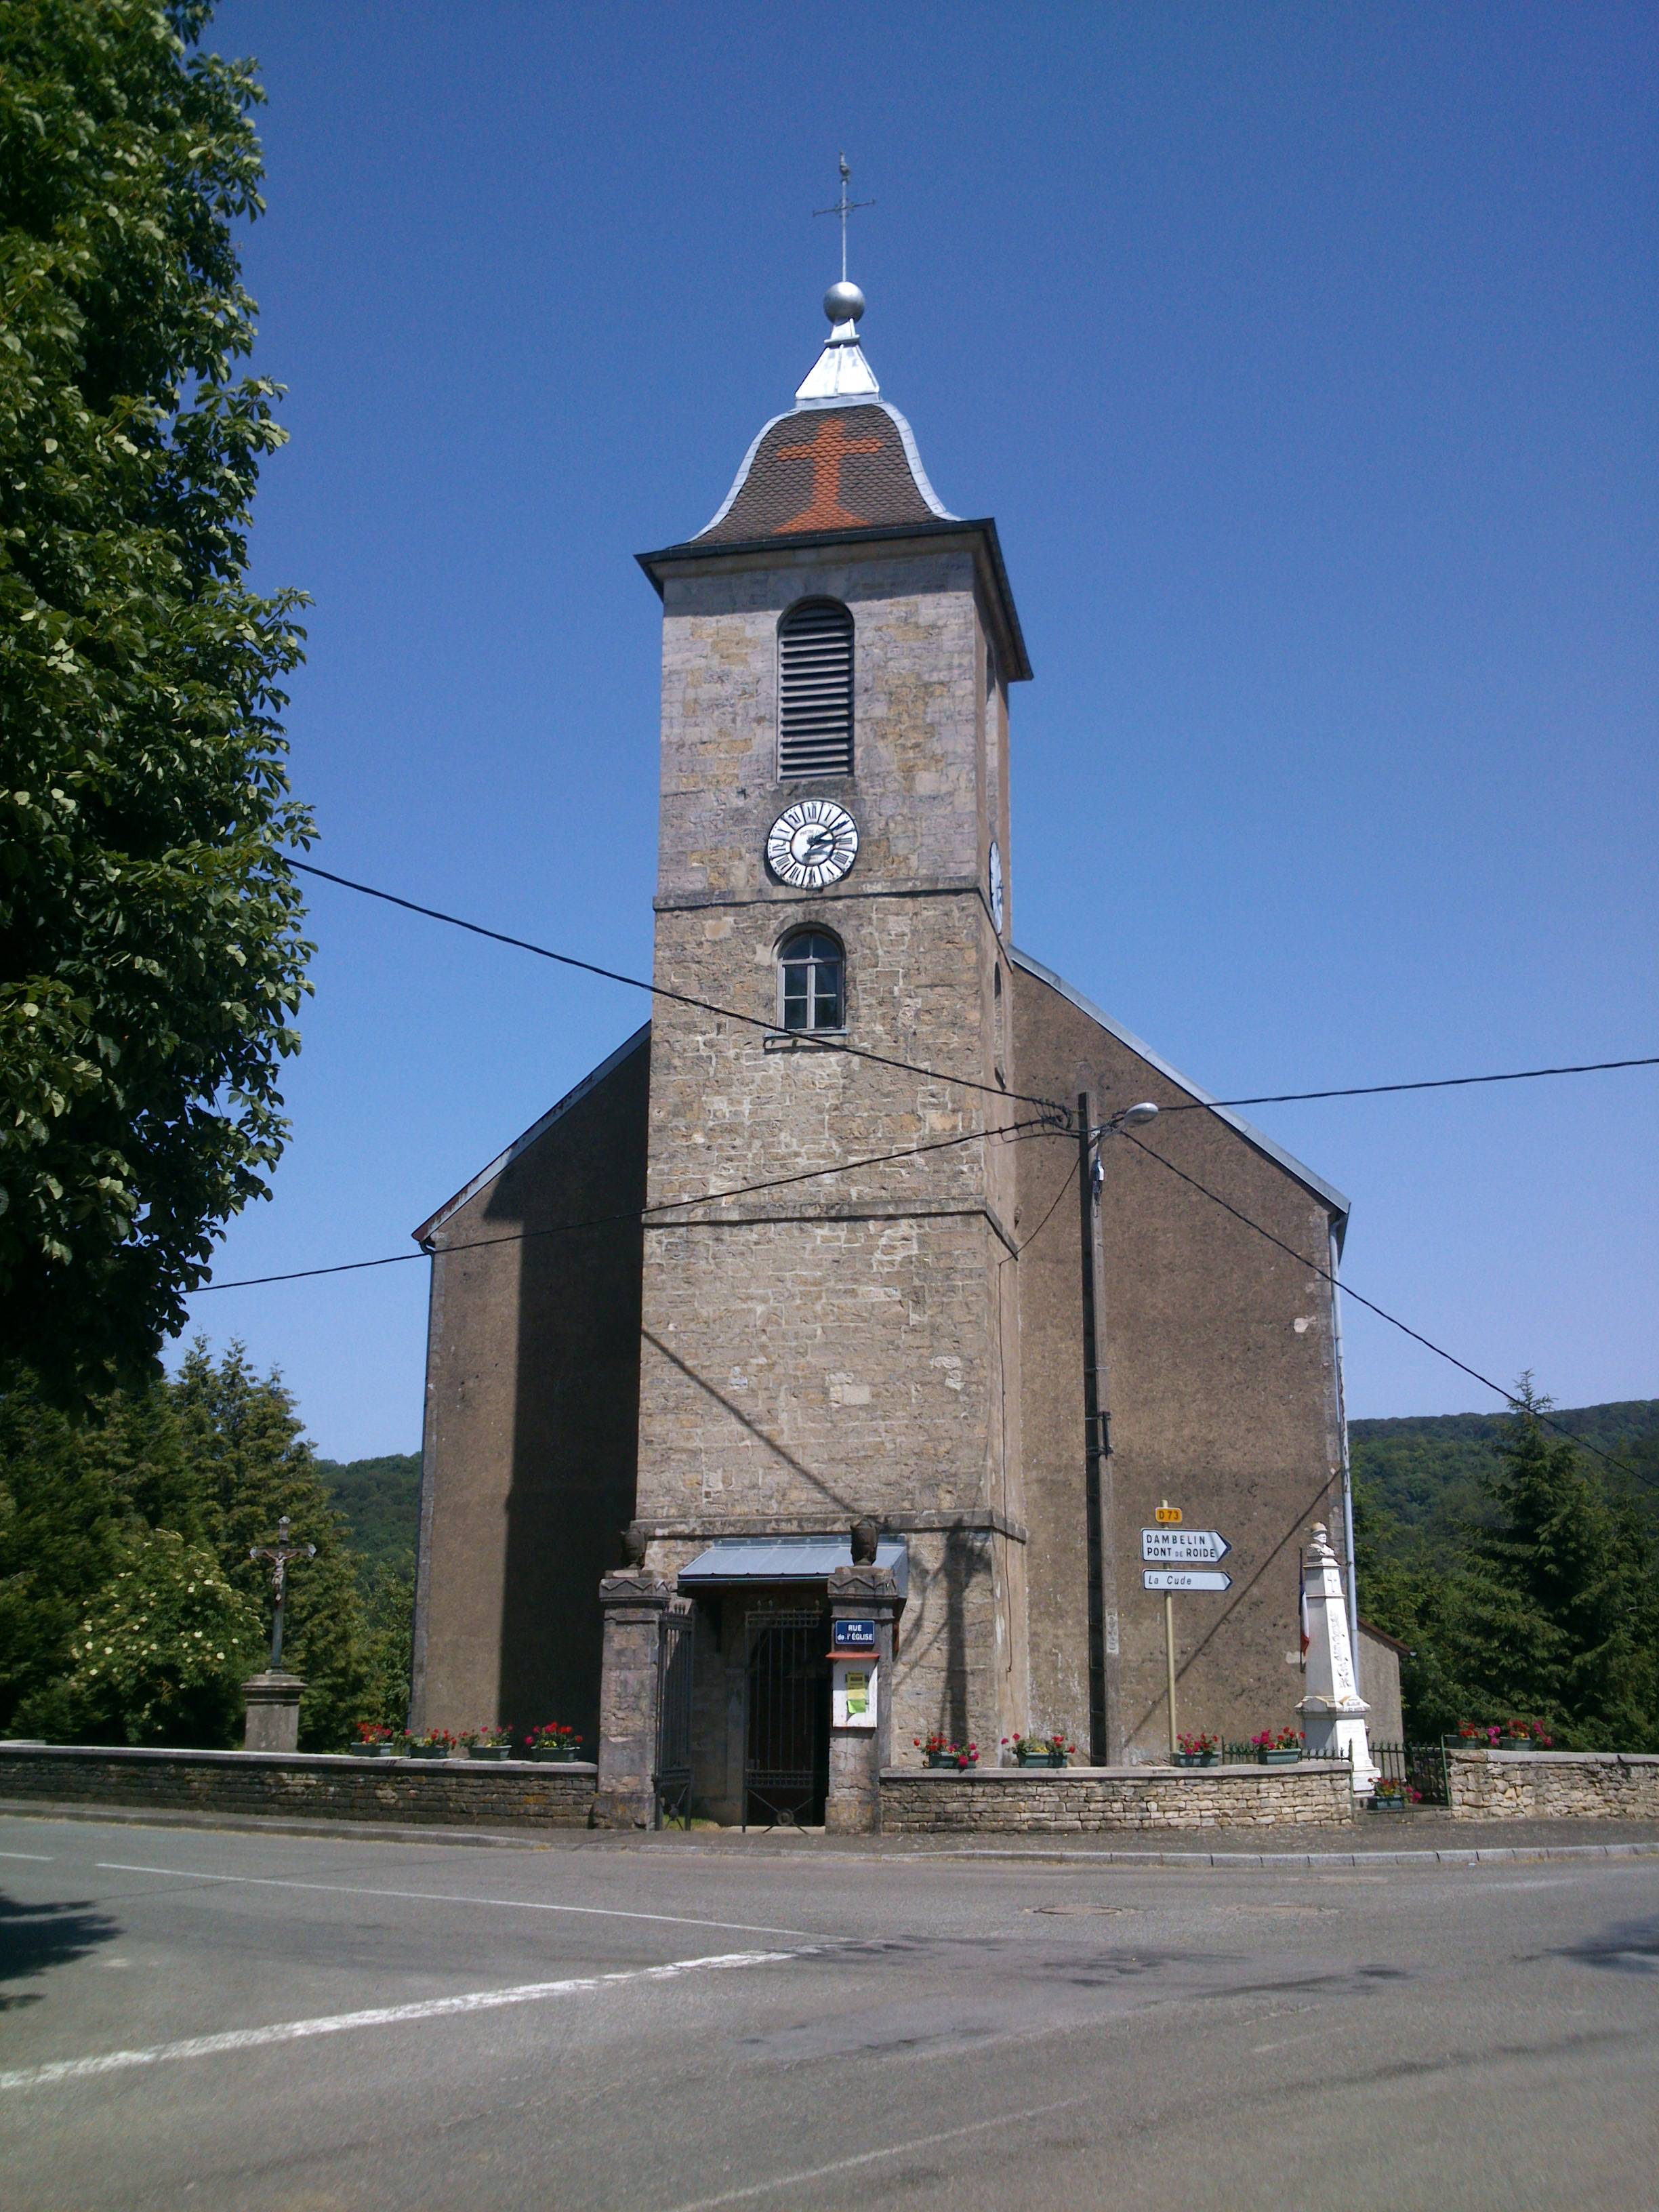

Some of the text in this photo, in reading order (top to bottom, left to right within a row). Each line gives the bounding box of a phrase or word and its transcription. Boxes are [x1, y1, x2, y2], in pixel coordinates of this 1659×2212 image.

[1159, 1511, 1179, 1519] D 73
[1147, 1534, 1206, 1545] DAMBELIN
[1147, 1547, 1172, 1557] PONT
[1186, 1548, 1216, 1557] ROIDE
[1148, 1575, 1192, 1585] La Cude
